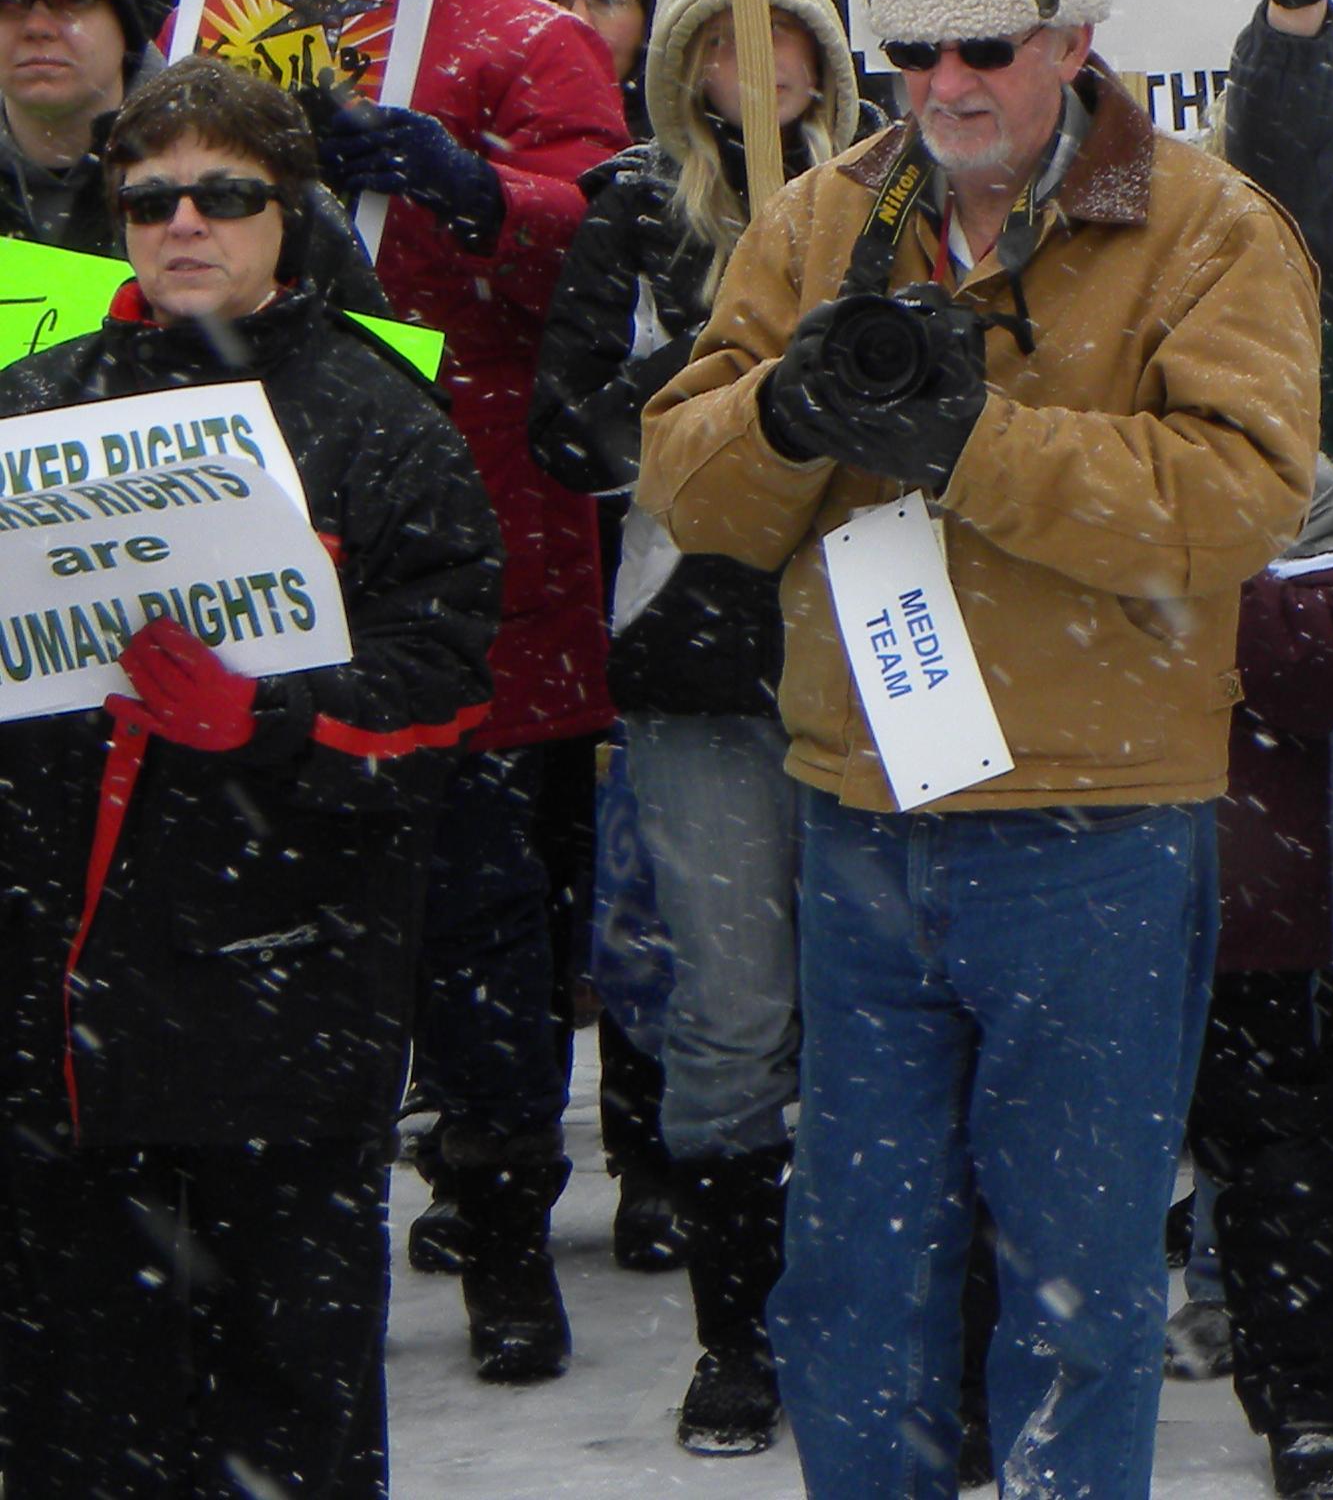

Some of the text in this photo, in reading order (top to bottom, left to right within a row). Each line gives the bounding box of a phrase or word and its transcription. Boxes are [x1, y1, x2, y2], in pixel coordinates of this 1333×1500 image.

[878, 164, 920, 225] Nikon
[101, 413, 266, 478] RIGHTS
[70, 463, 250, 518] RIGHTS
[47, 535, 171, 577] are
[0, 567, 316, 683] UMAN RIGHTS
[866, 608, 912, 700] TEAM
[898, 586, 950, 692] MEDIA
